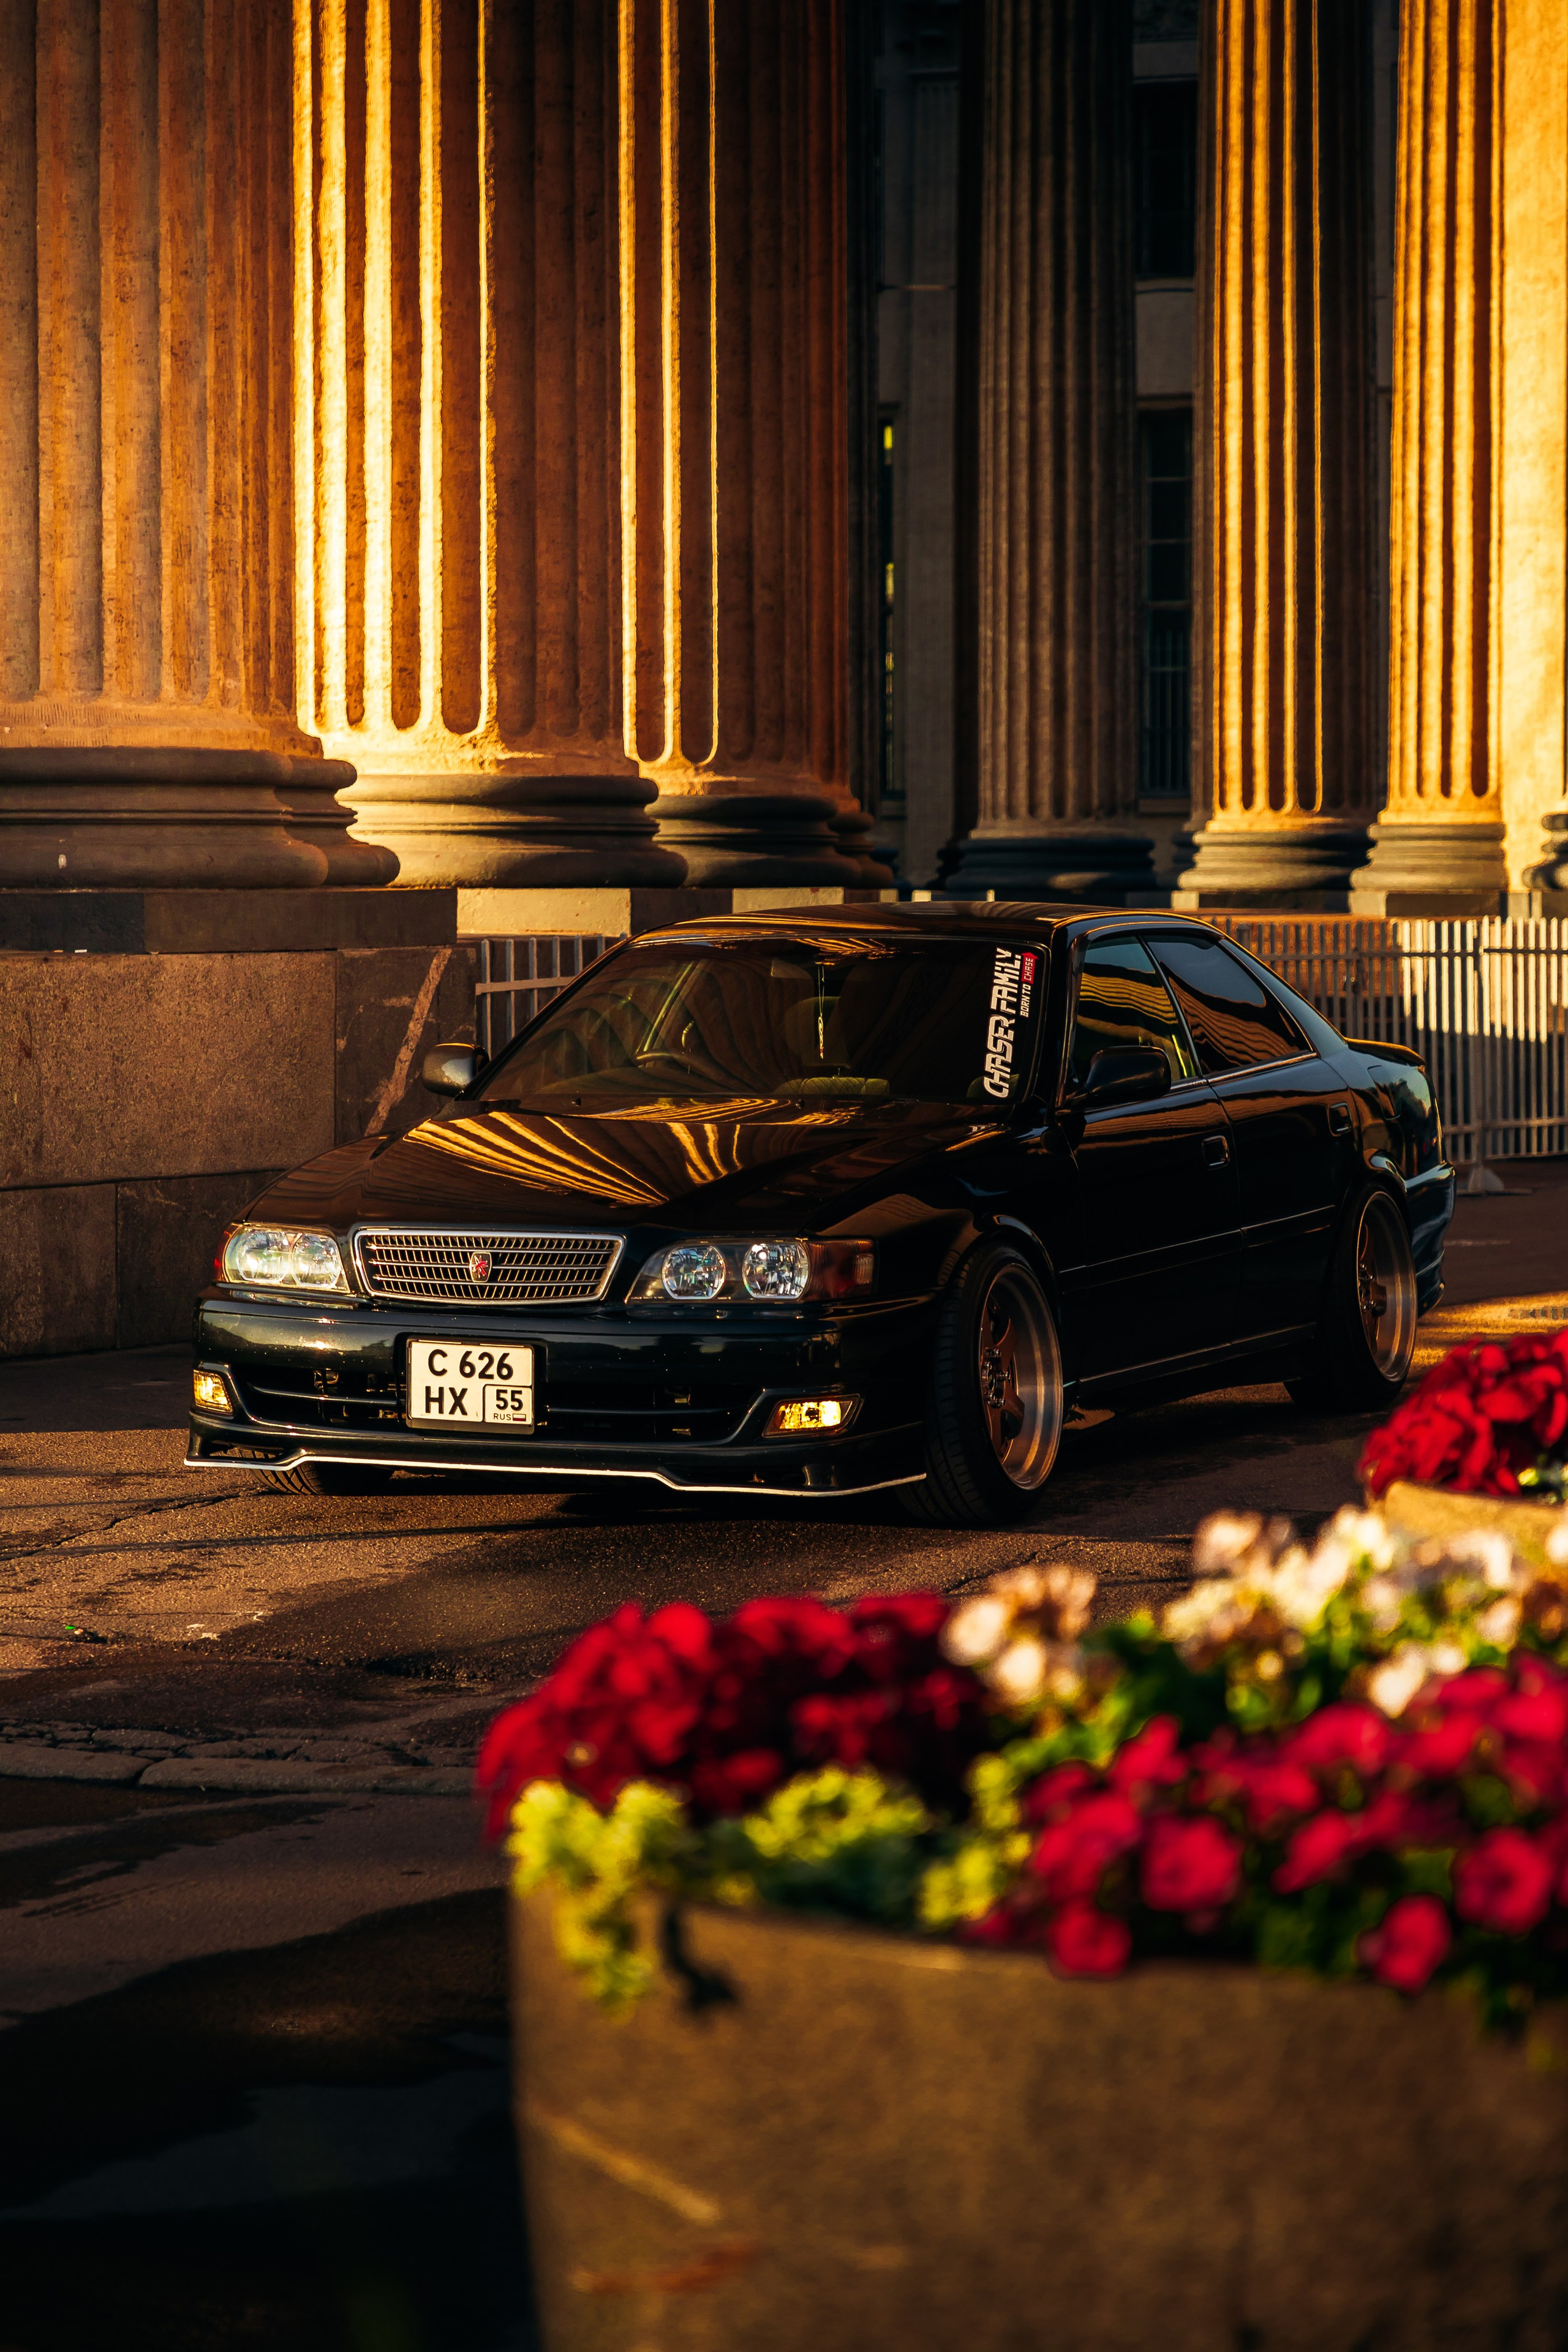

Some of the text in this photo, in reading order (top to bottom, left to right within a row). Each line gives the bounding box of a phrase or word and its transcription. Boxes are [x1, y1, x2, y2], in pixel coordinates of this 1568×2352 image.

[1020, 957, 1033, 1018] BORN TO CHASE
[984, 1015, 1016, 1098] CHASER
[459, 1351, 513, 1380] 626
[496, 1389, 524, 1411] 55
